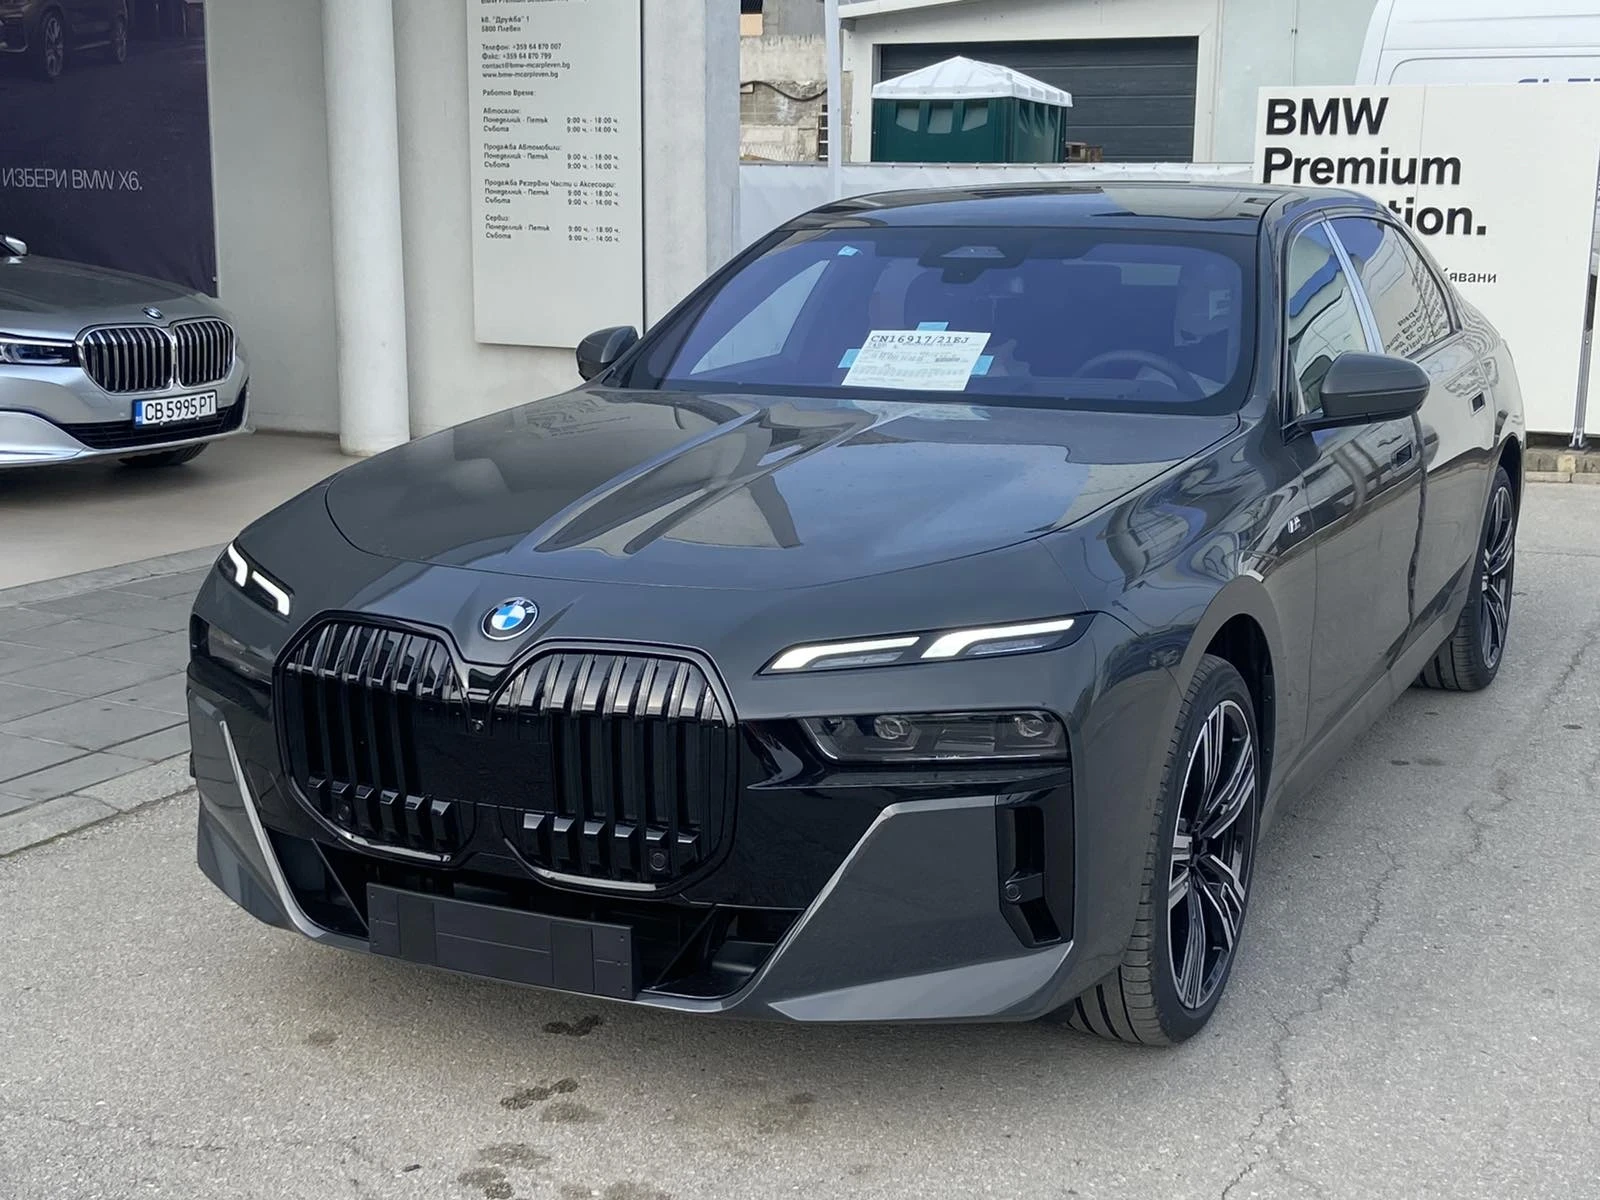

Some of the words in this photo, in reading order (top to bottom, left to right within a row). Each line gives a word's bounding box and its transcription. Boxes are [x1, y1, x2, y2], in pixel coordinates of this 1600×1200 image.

[1265, 96, 1389, 136] BMW
[483, 116, 520, 126] Понеделник
[484, 143, 516, 152] Продажба
[484, 151, 521, 160] Понеделник
[1263, 147, 1461, 185] Premium
[2, 167, 68, 189] ИЗБЕРИ
[71, 169, 115, 190] BMW
[118, 170, 143, 191] X6.
[485, 179, 517, 187] Продажба
[485, 188, 522, 197] Понеделник
[485, 196, 510, 204] Събота
[486, 223, 522, 232] Понеделник
[486, 231, 511, 239] Събота
[145, 403, 163, 420] CB
[166, 398, 197, 418] 5995
[199, 395, 215, 413] PT
